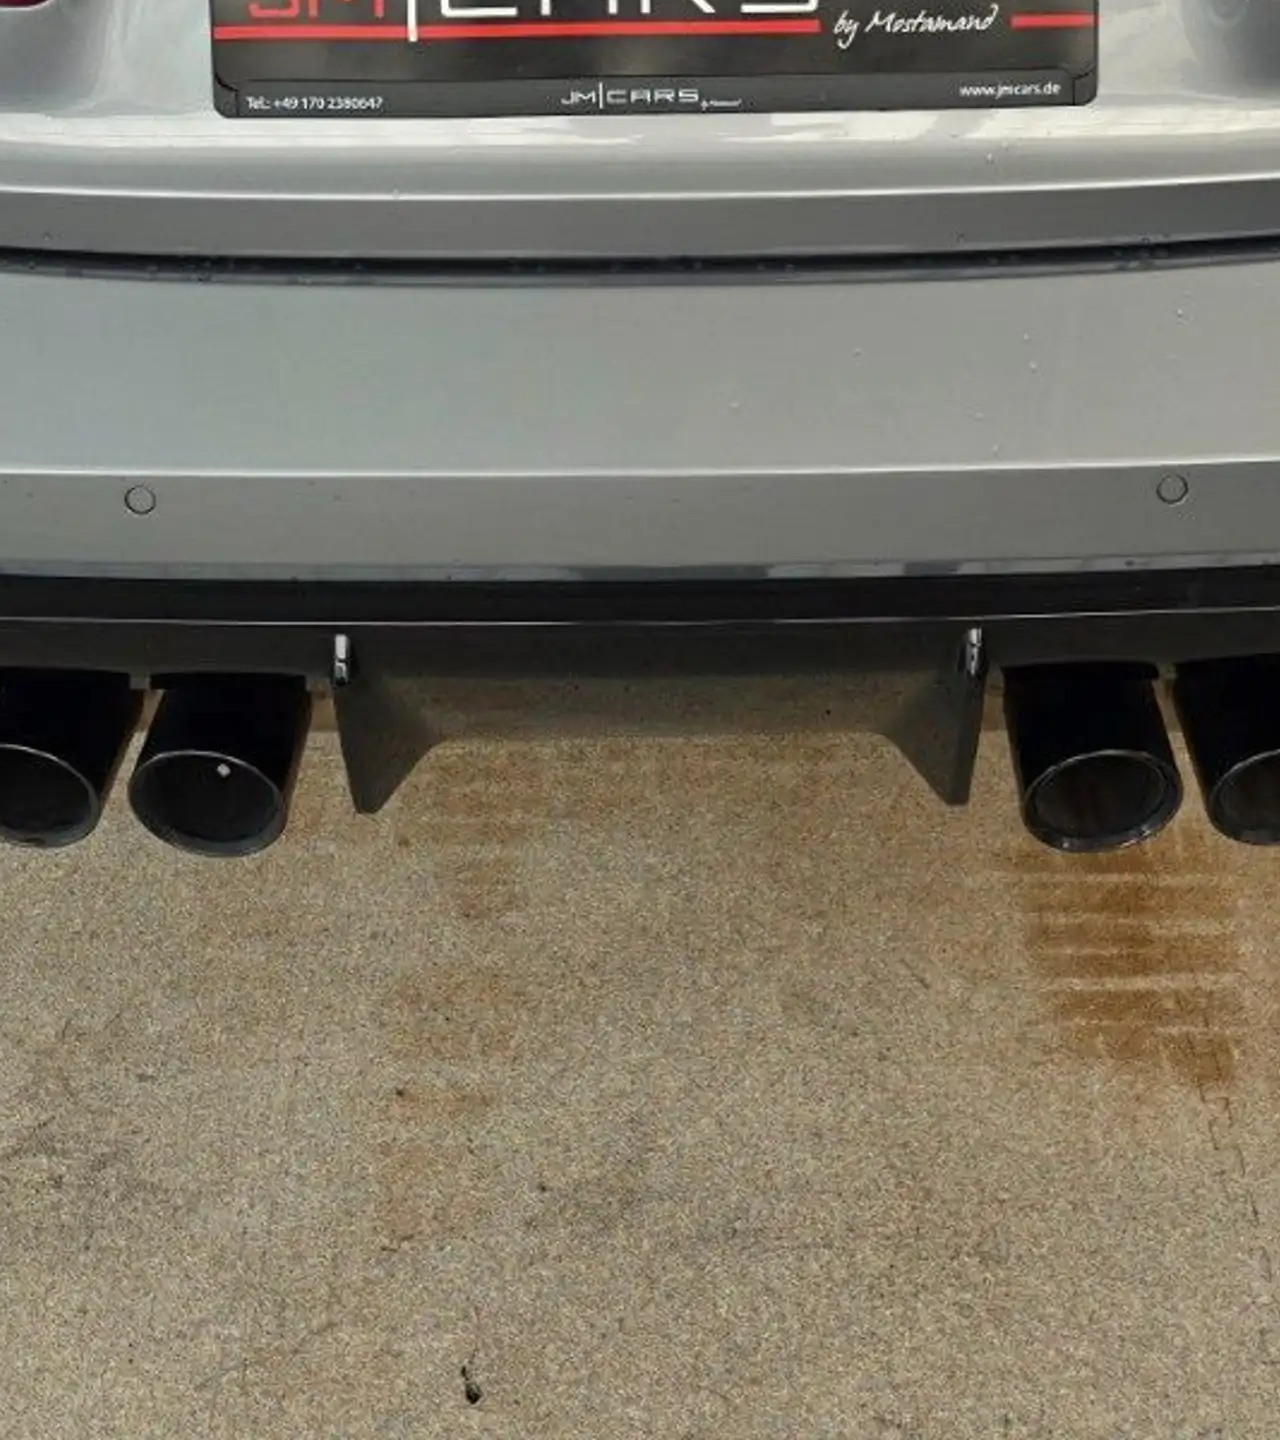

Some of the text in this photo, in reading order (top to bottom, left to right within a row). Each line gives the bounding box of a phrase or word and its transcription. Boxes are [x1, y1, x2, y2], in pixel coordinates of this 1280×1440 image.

[832, 9, 861, 50] by
[605, 88, 699, 105] CARS
[959, 81, 1062, 100] www.jmcars.de
[273, 95, 299, 110] +49
[301, 95, 325, 110] 170
